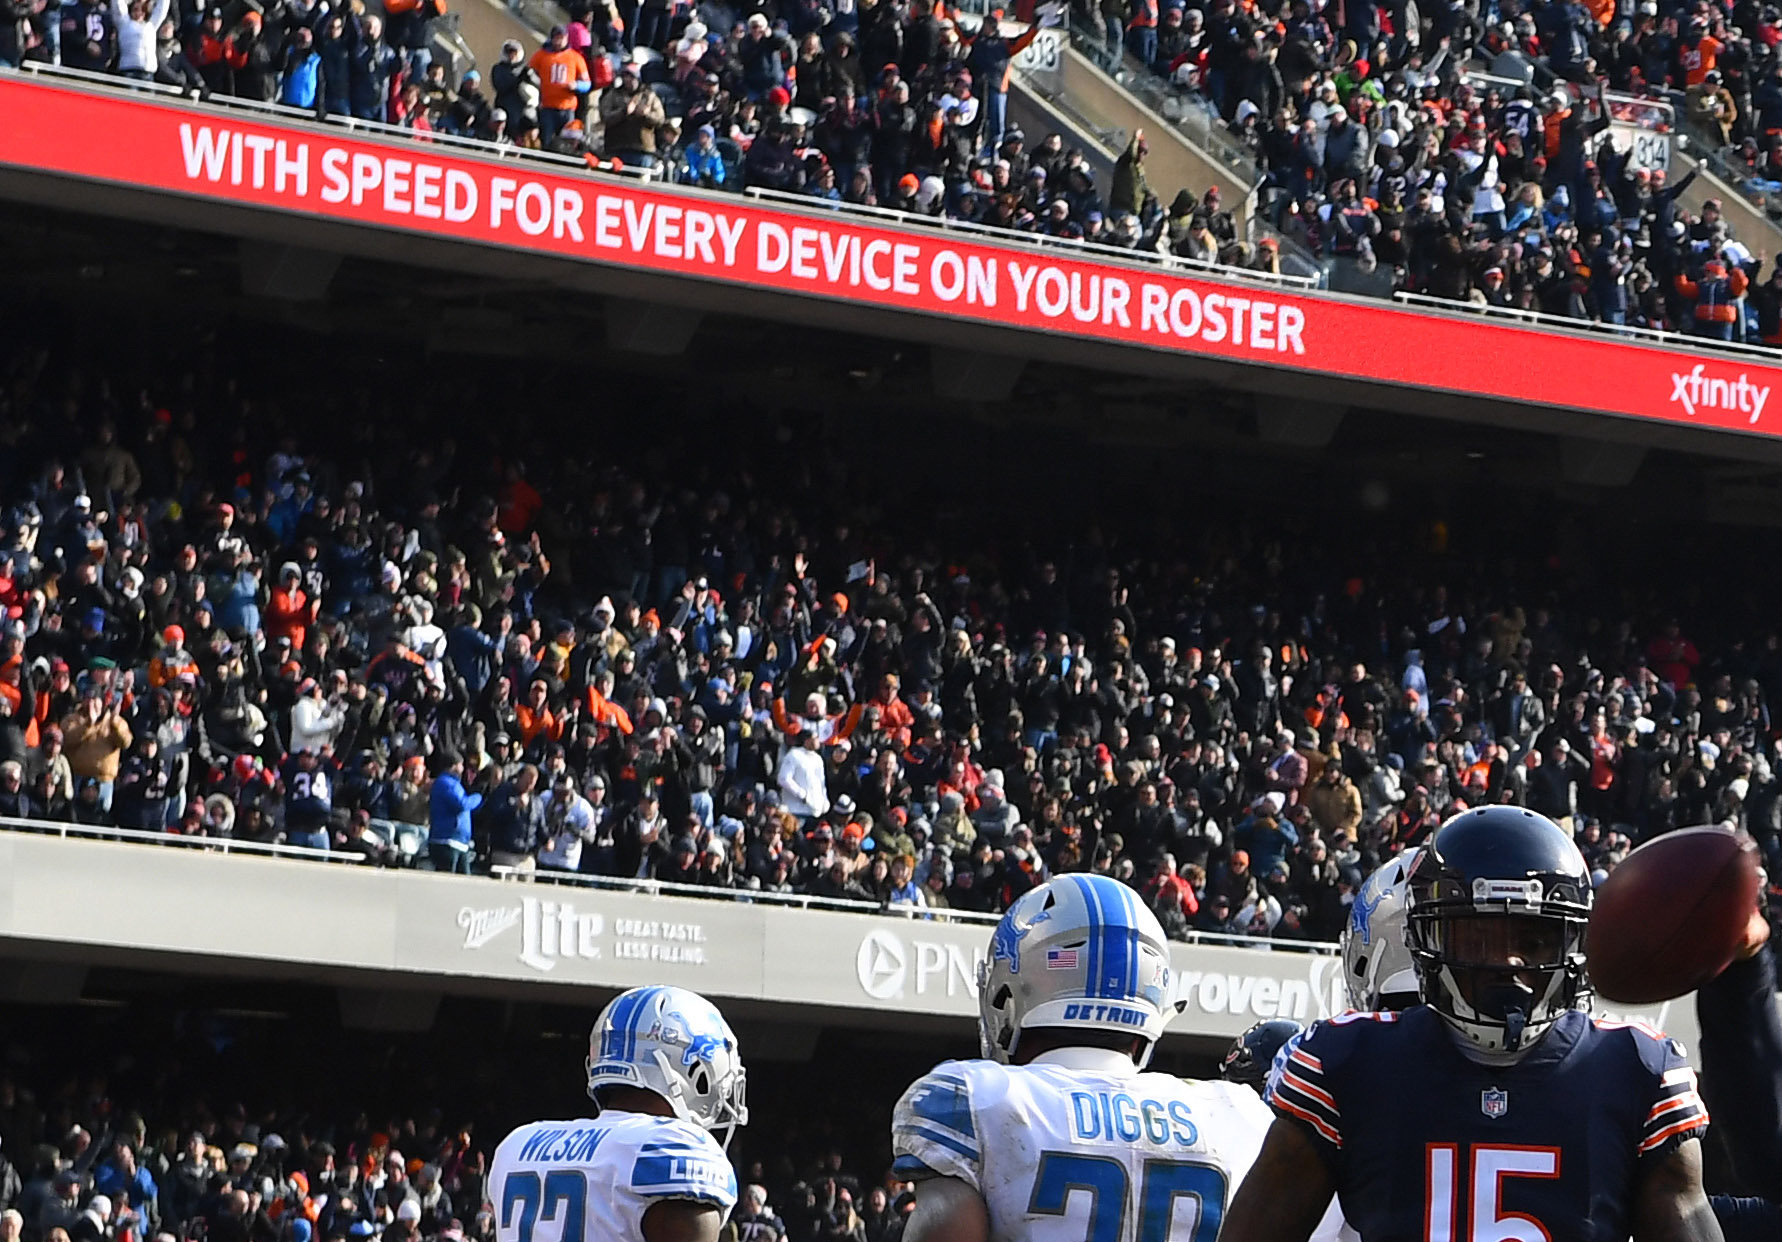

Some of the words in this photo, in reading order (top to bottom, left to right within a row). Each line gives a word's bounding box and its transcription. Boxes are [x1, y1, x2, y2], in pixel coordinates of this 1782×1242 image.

[179, 123, 309, 197] WITH
[321, 147, 478, 222] SPEED
[489, 177, 585, 243] FOR
[596, 195, 747, 267] EVERY
[757, 222, 920, 295] DEVICE
[931, 250, 997, 307] ON
[1007, 262, 1131, 329] YOUR
[1141, 283, 1305, 354] ROSTER
[1670, 364, 1770, 424] xfinity
[518, 897, 603, 971] Lite
[615, 942, 649, 960] LESS
[1063, 1003, 1150, 1027] DETROIT
[1168, 971, 1308, 1018] roven
[1070, 1090, 1200, 1147] DIGGS
[518, 1127, 612, 1163] WILSON
